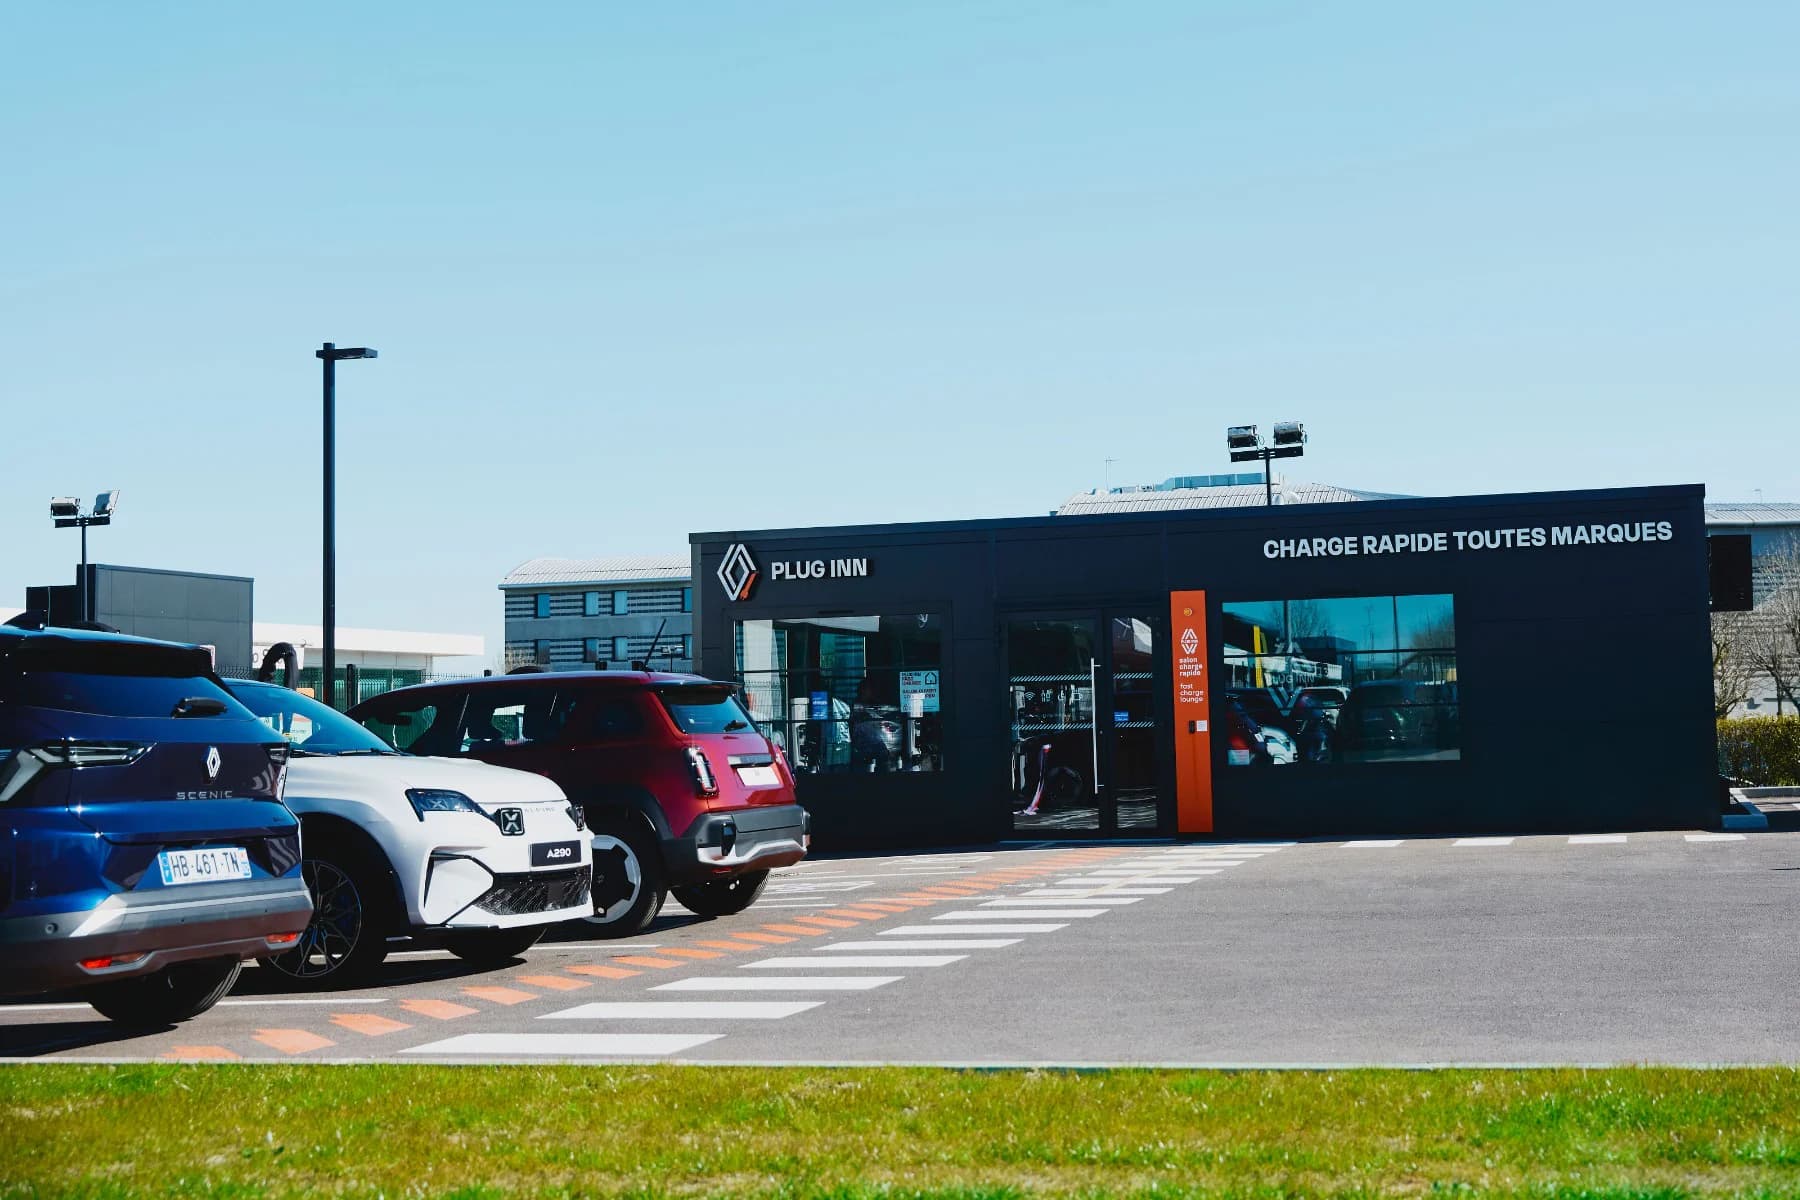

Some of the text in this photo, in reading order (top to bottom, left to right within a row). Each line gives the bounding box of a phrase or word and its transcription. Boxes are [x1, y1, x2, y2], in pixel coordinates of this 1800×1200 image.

[1263, 521, 1673, 559] CHARGE RAPIDE TOUTES MARQUES
[771, 558, 867, 580] PLUG INN
[1179, 670, 1201, 678] rapide
[175, 790, 233, 800] SCENIC
[546, 847, 572, 859] A290
